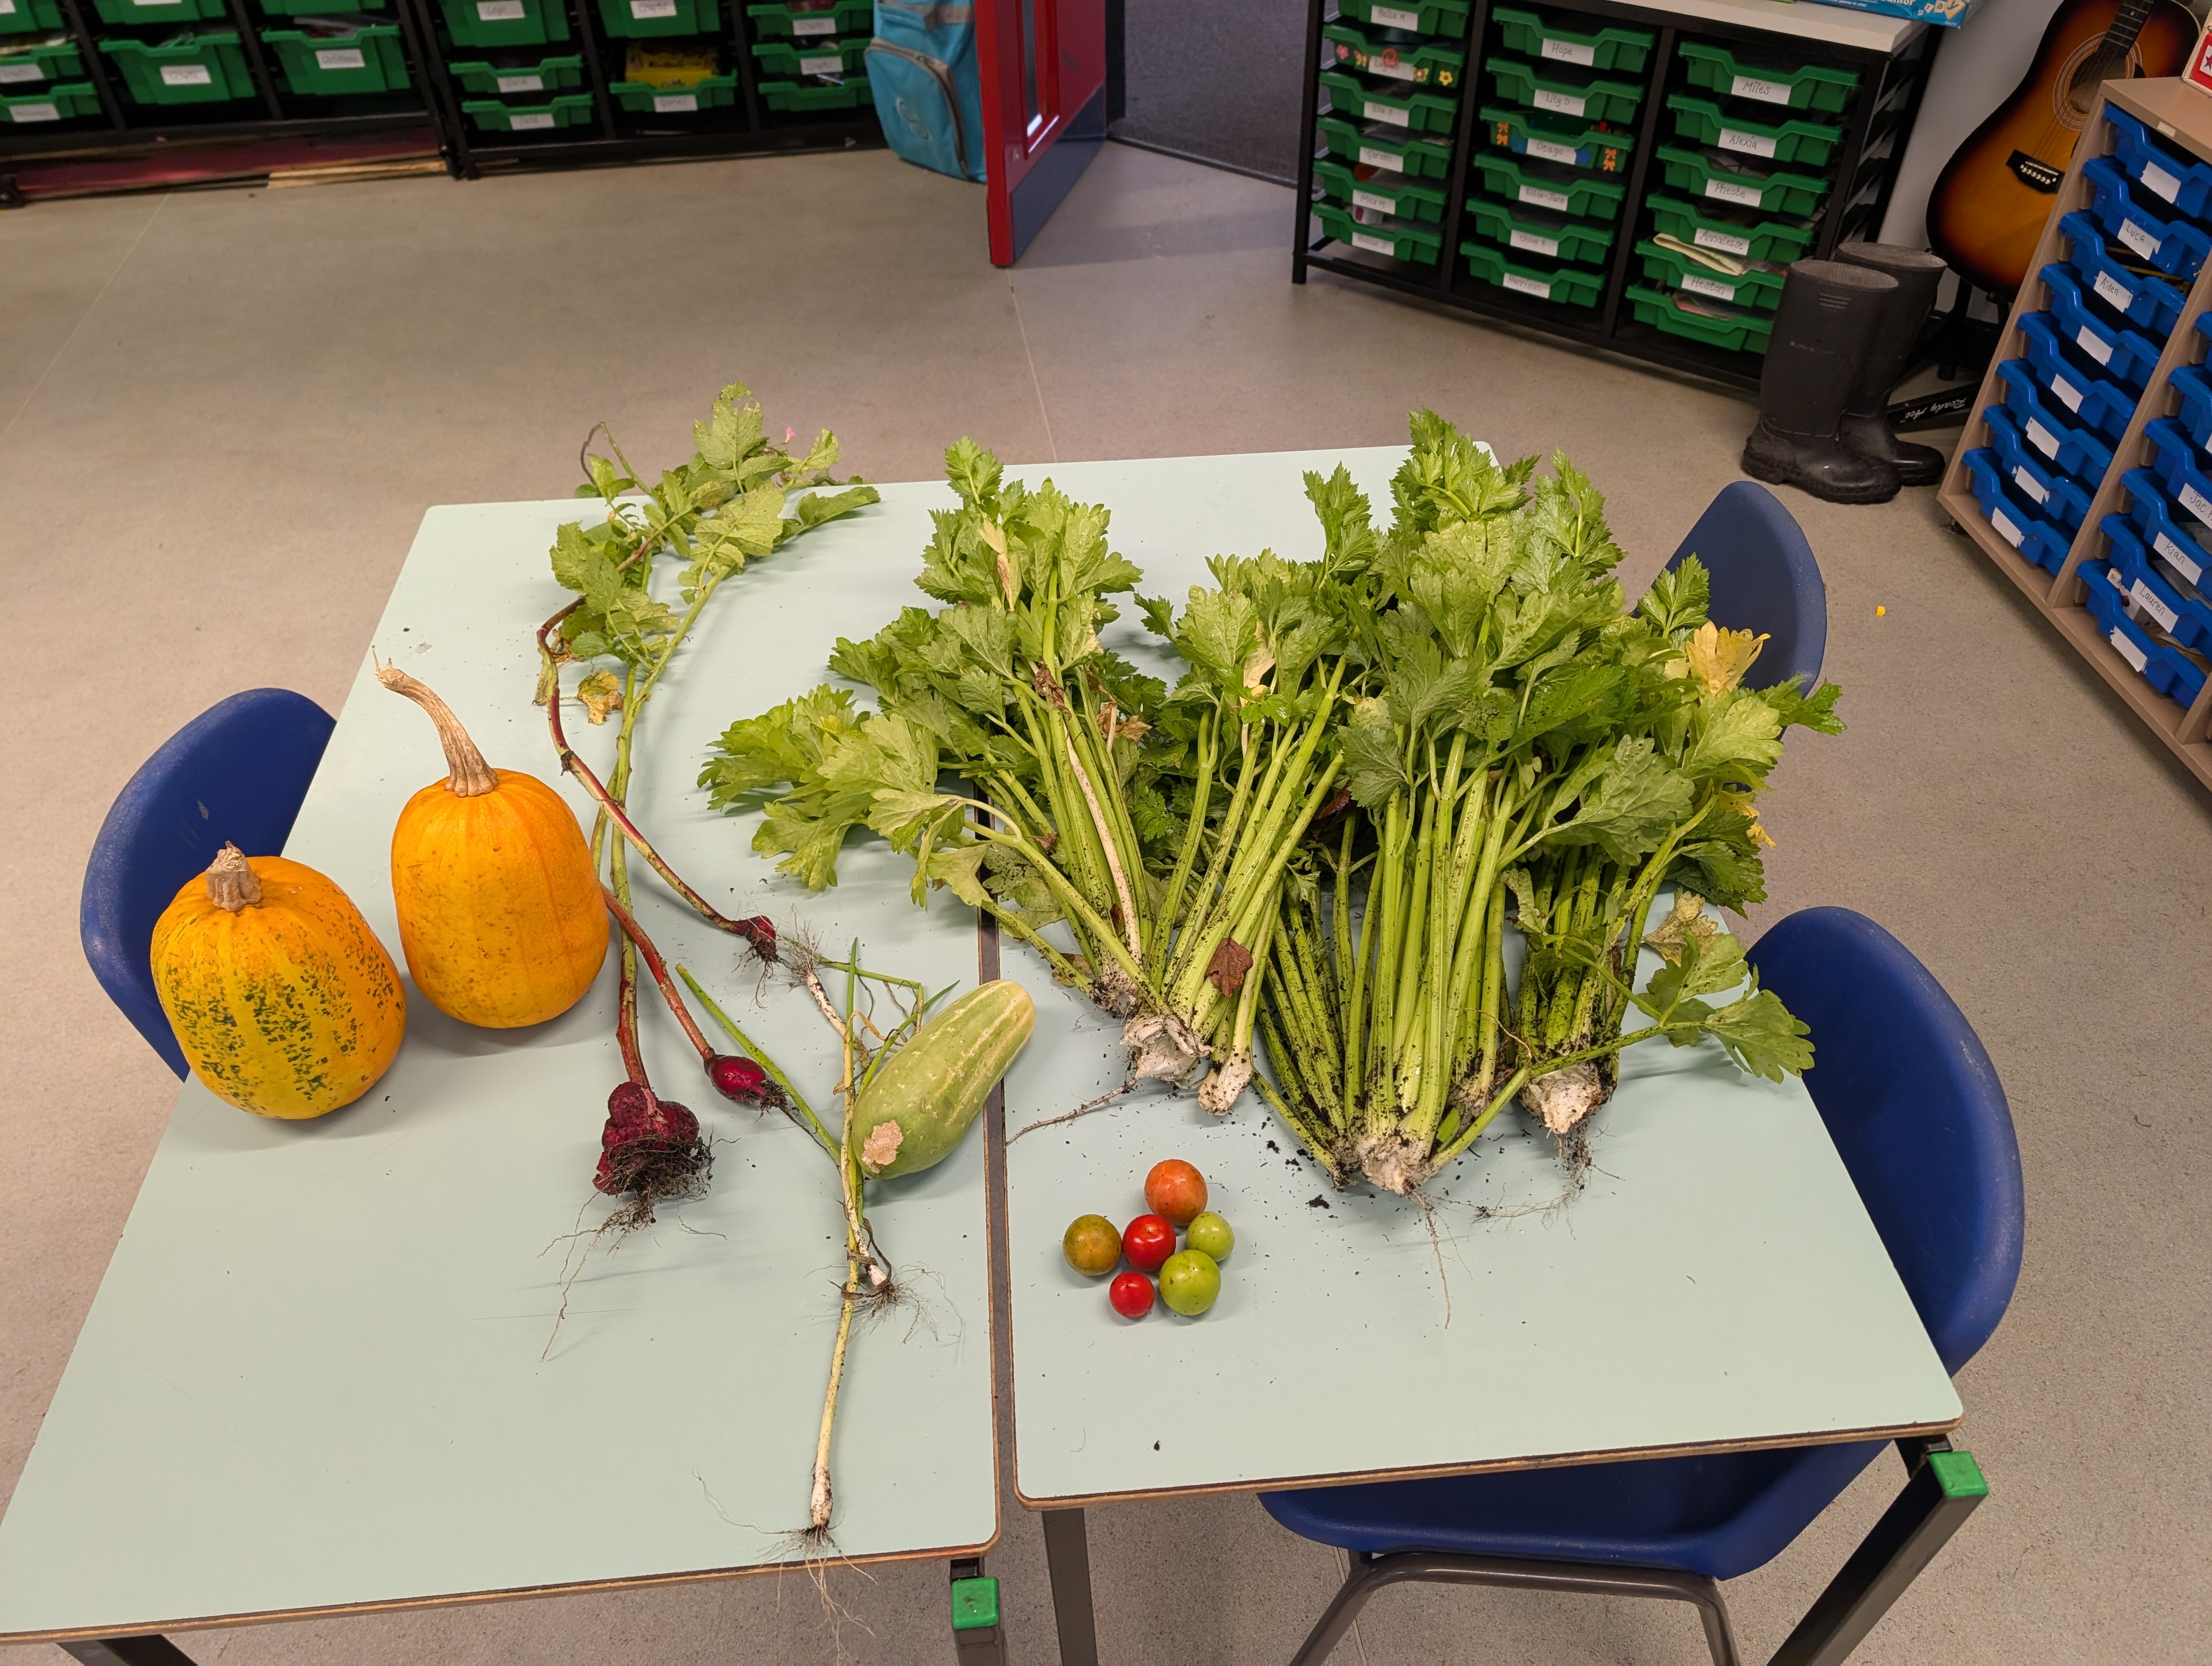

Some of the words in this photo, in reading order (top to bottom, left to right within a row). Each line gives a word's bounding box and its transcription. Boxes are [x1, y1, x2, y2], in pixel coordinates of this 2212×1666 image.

[1551, 43, 1572, 57] Hope
[1742, 82, 1771, 95] Miles
[1546, 93, 1561, 108] Lily
[1729, 136, 1757, 150] Alexia
[1714, 182, 1746, 198] Pheobe
[2126, 224, 2145, 244] LUCA
[1691, 277, 1725, 296] Heston
[2100, 277, 2119, 296] Aiden
[1930, 397, 1967, 414] Ready
[2190, 490, 2206, 513] Jac
[2164, 541, 2185, 565] Kian
[2139, 585, 2165, 616] Lauren
